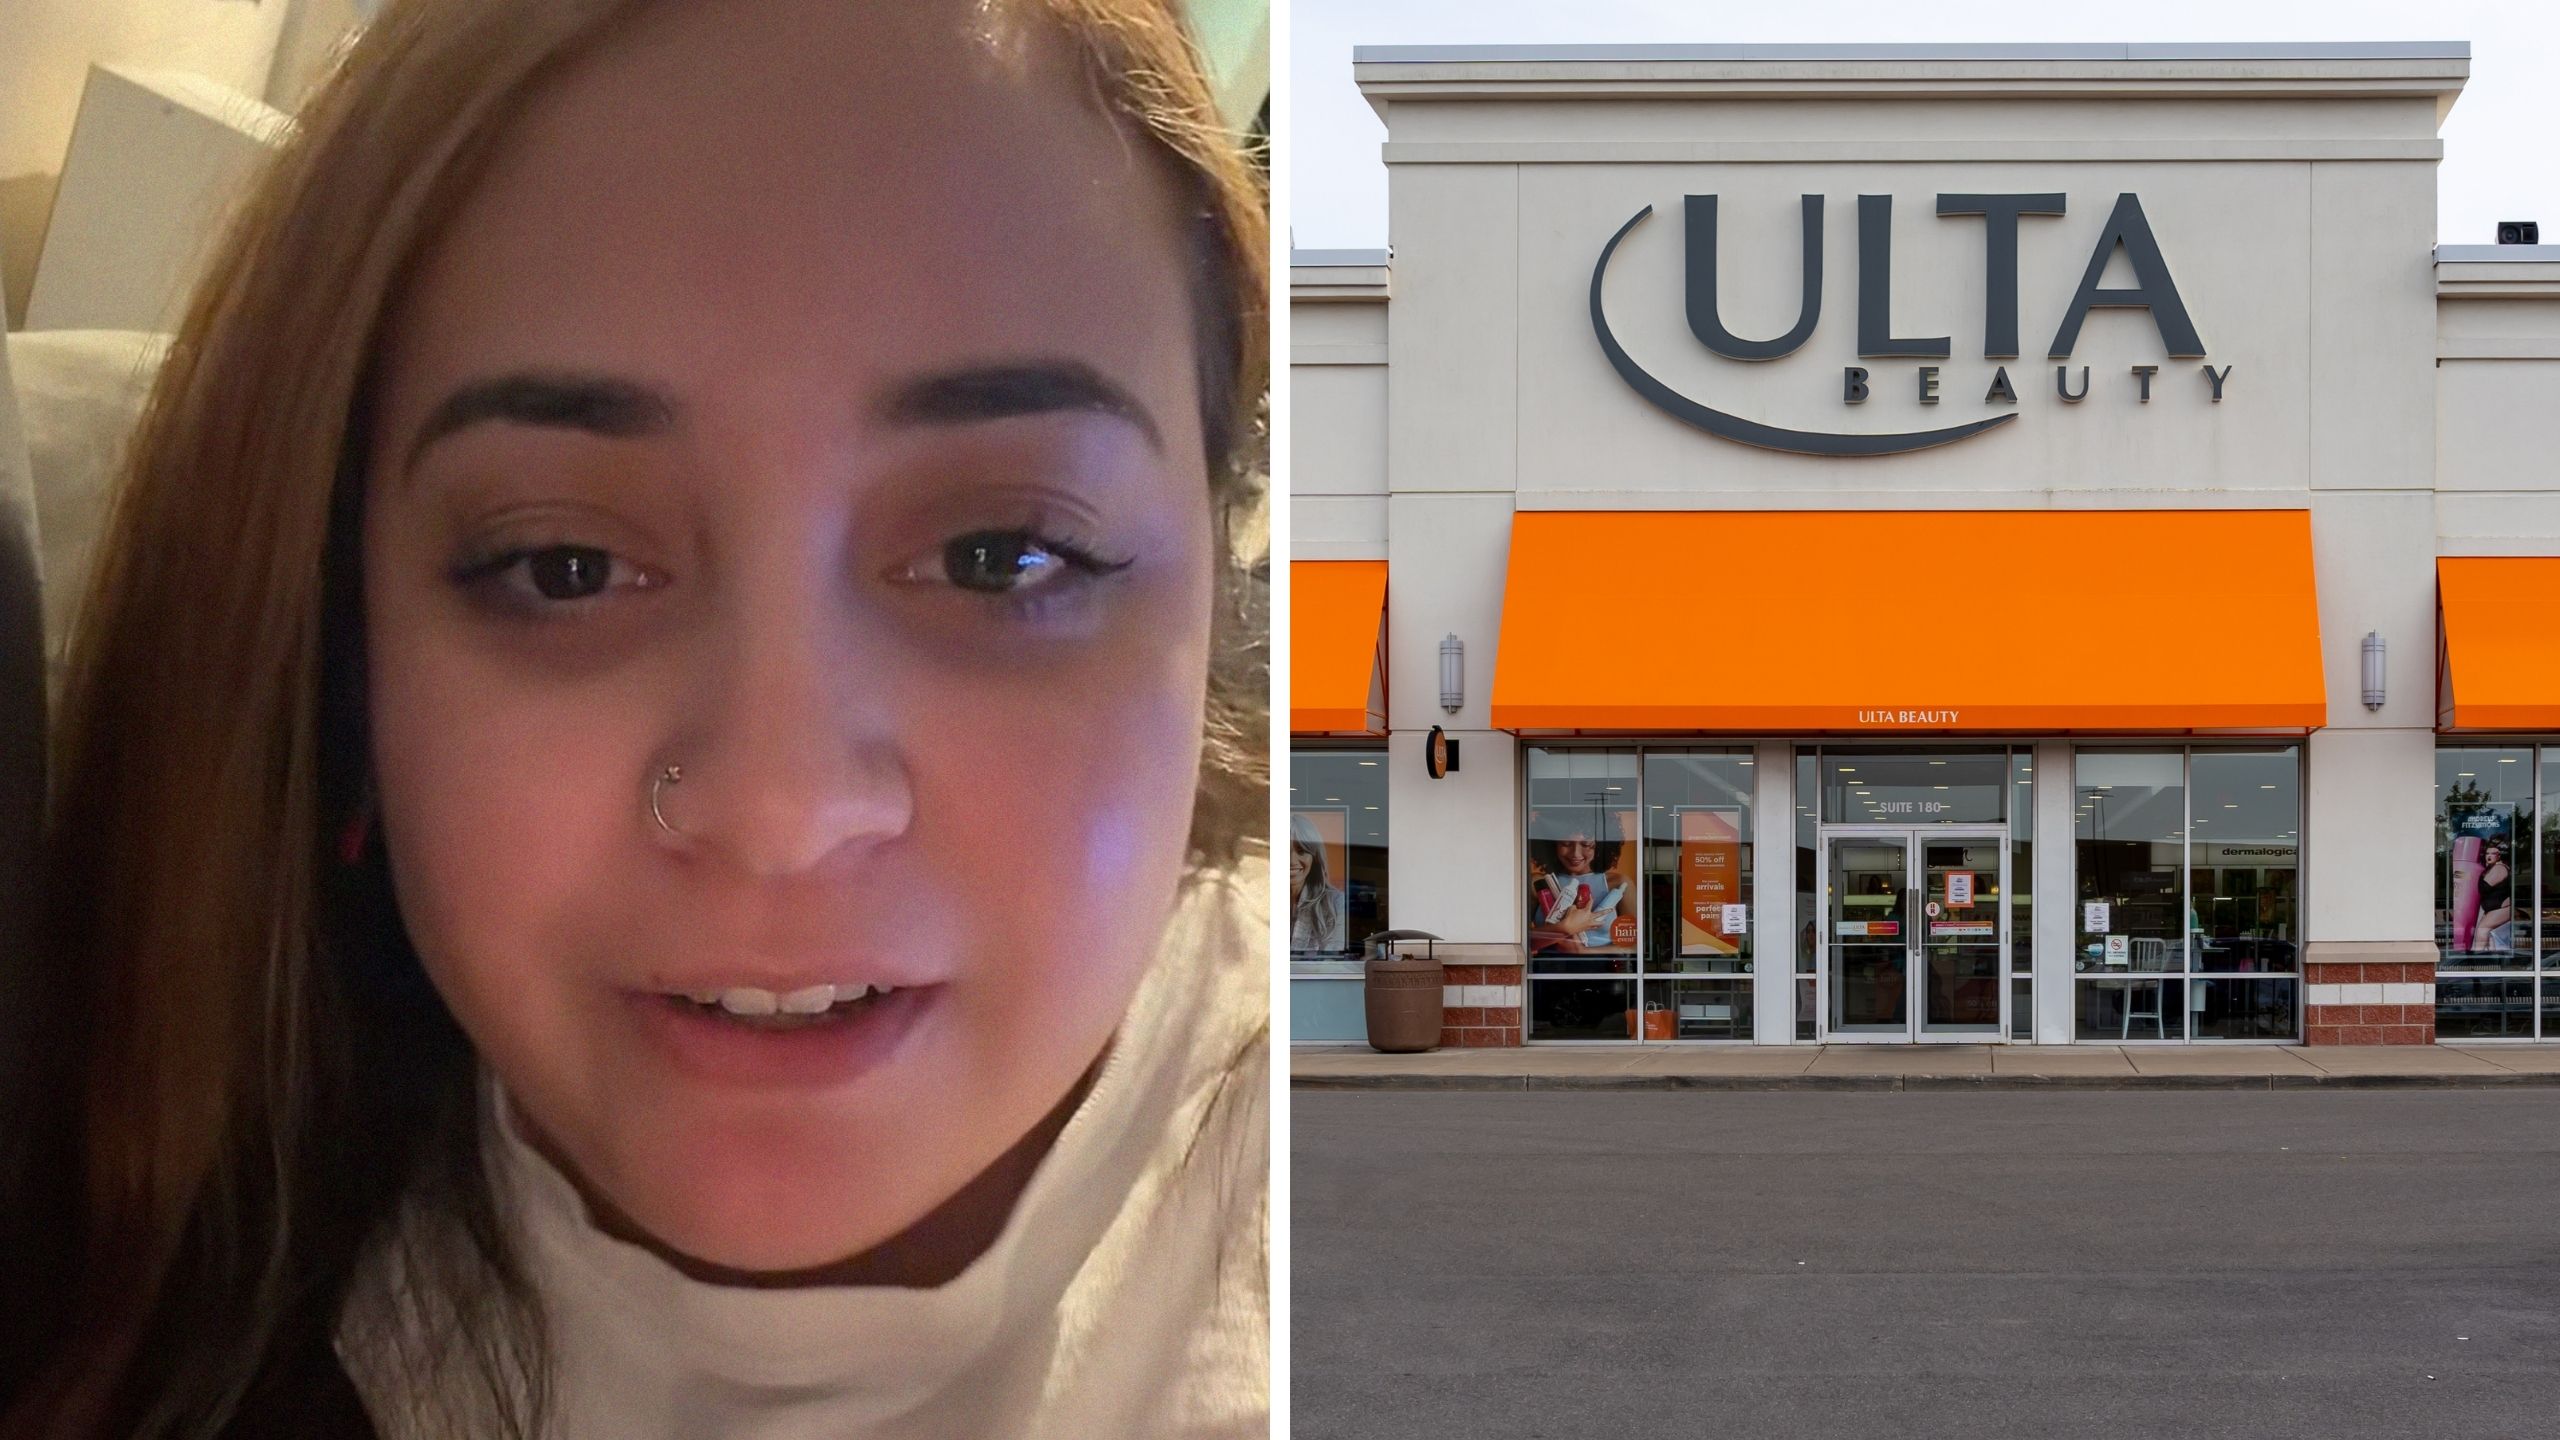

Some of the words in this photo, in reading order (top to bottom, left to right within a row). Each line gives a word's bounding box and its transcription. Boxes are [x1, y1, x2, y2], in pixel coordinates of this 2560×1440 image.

[1683, 192, 2207, 362] ULTA
[1843, 364, 2233, 404] BEAUTY
[1858, 710, 1895, 723] ULTA
[1899, 710, 1959, 723] BEAUTY
[1880, 801, 1913, 813] SUITE
[1918, 801, 1941, 813] 180
[1714, 856, 1725, 864] off
[1696, 882, 1725, 891] arrivals
